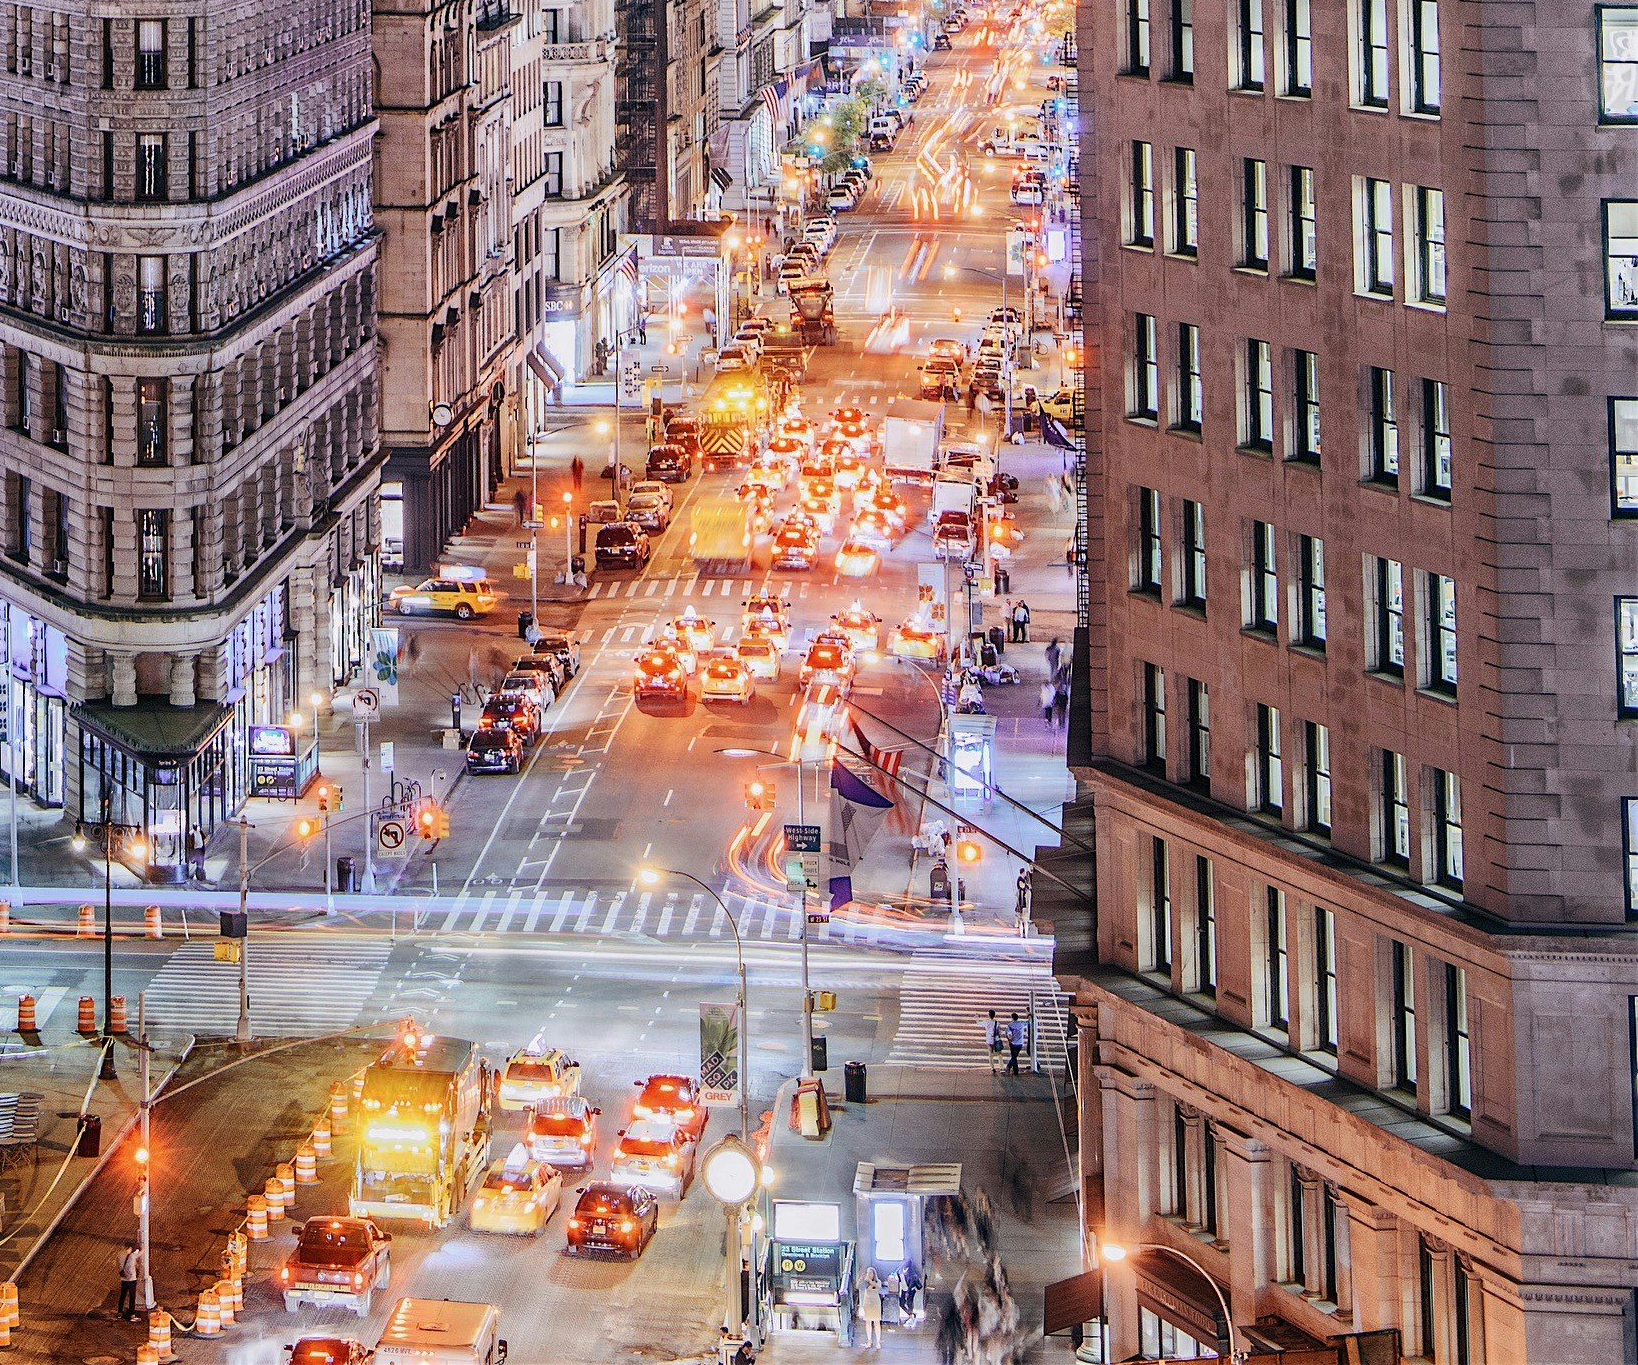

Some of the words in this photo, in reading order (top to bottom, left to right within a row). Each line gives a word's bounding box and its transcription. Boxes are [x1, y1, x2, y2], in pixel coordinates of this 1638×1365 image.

[785, 827, 802, 835] West
[804, 827, 819, 835] Side
[787, 834, 817, 843] Highway
[815, 915, 822, 923] 23
[701, 1056, 722, 1078] MAD.
[707, 1072, 725, 1087] SQ.
[704, 1091, 732, 1101] GREY
[781, 1245, 790, 1253] 23
[791, 1245, 810, 1254] Street
[811, 1246, 835, 1255] Station
